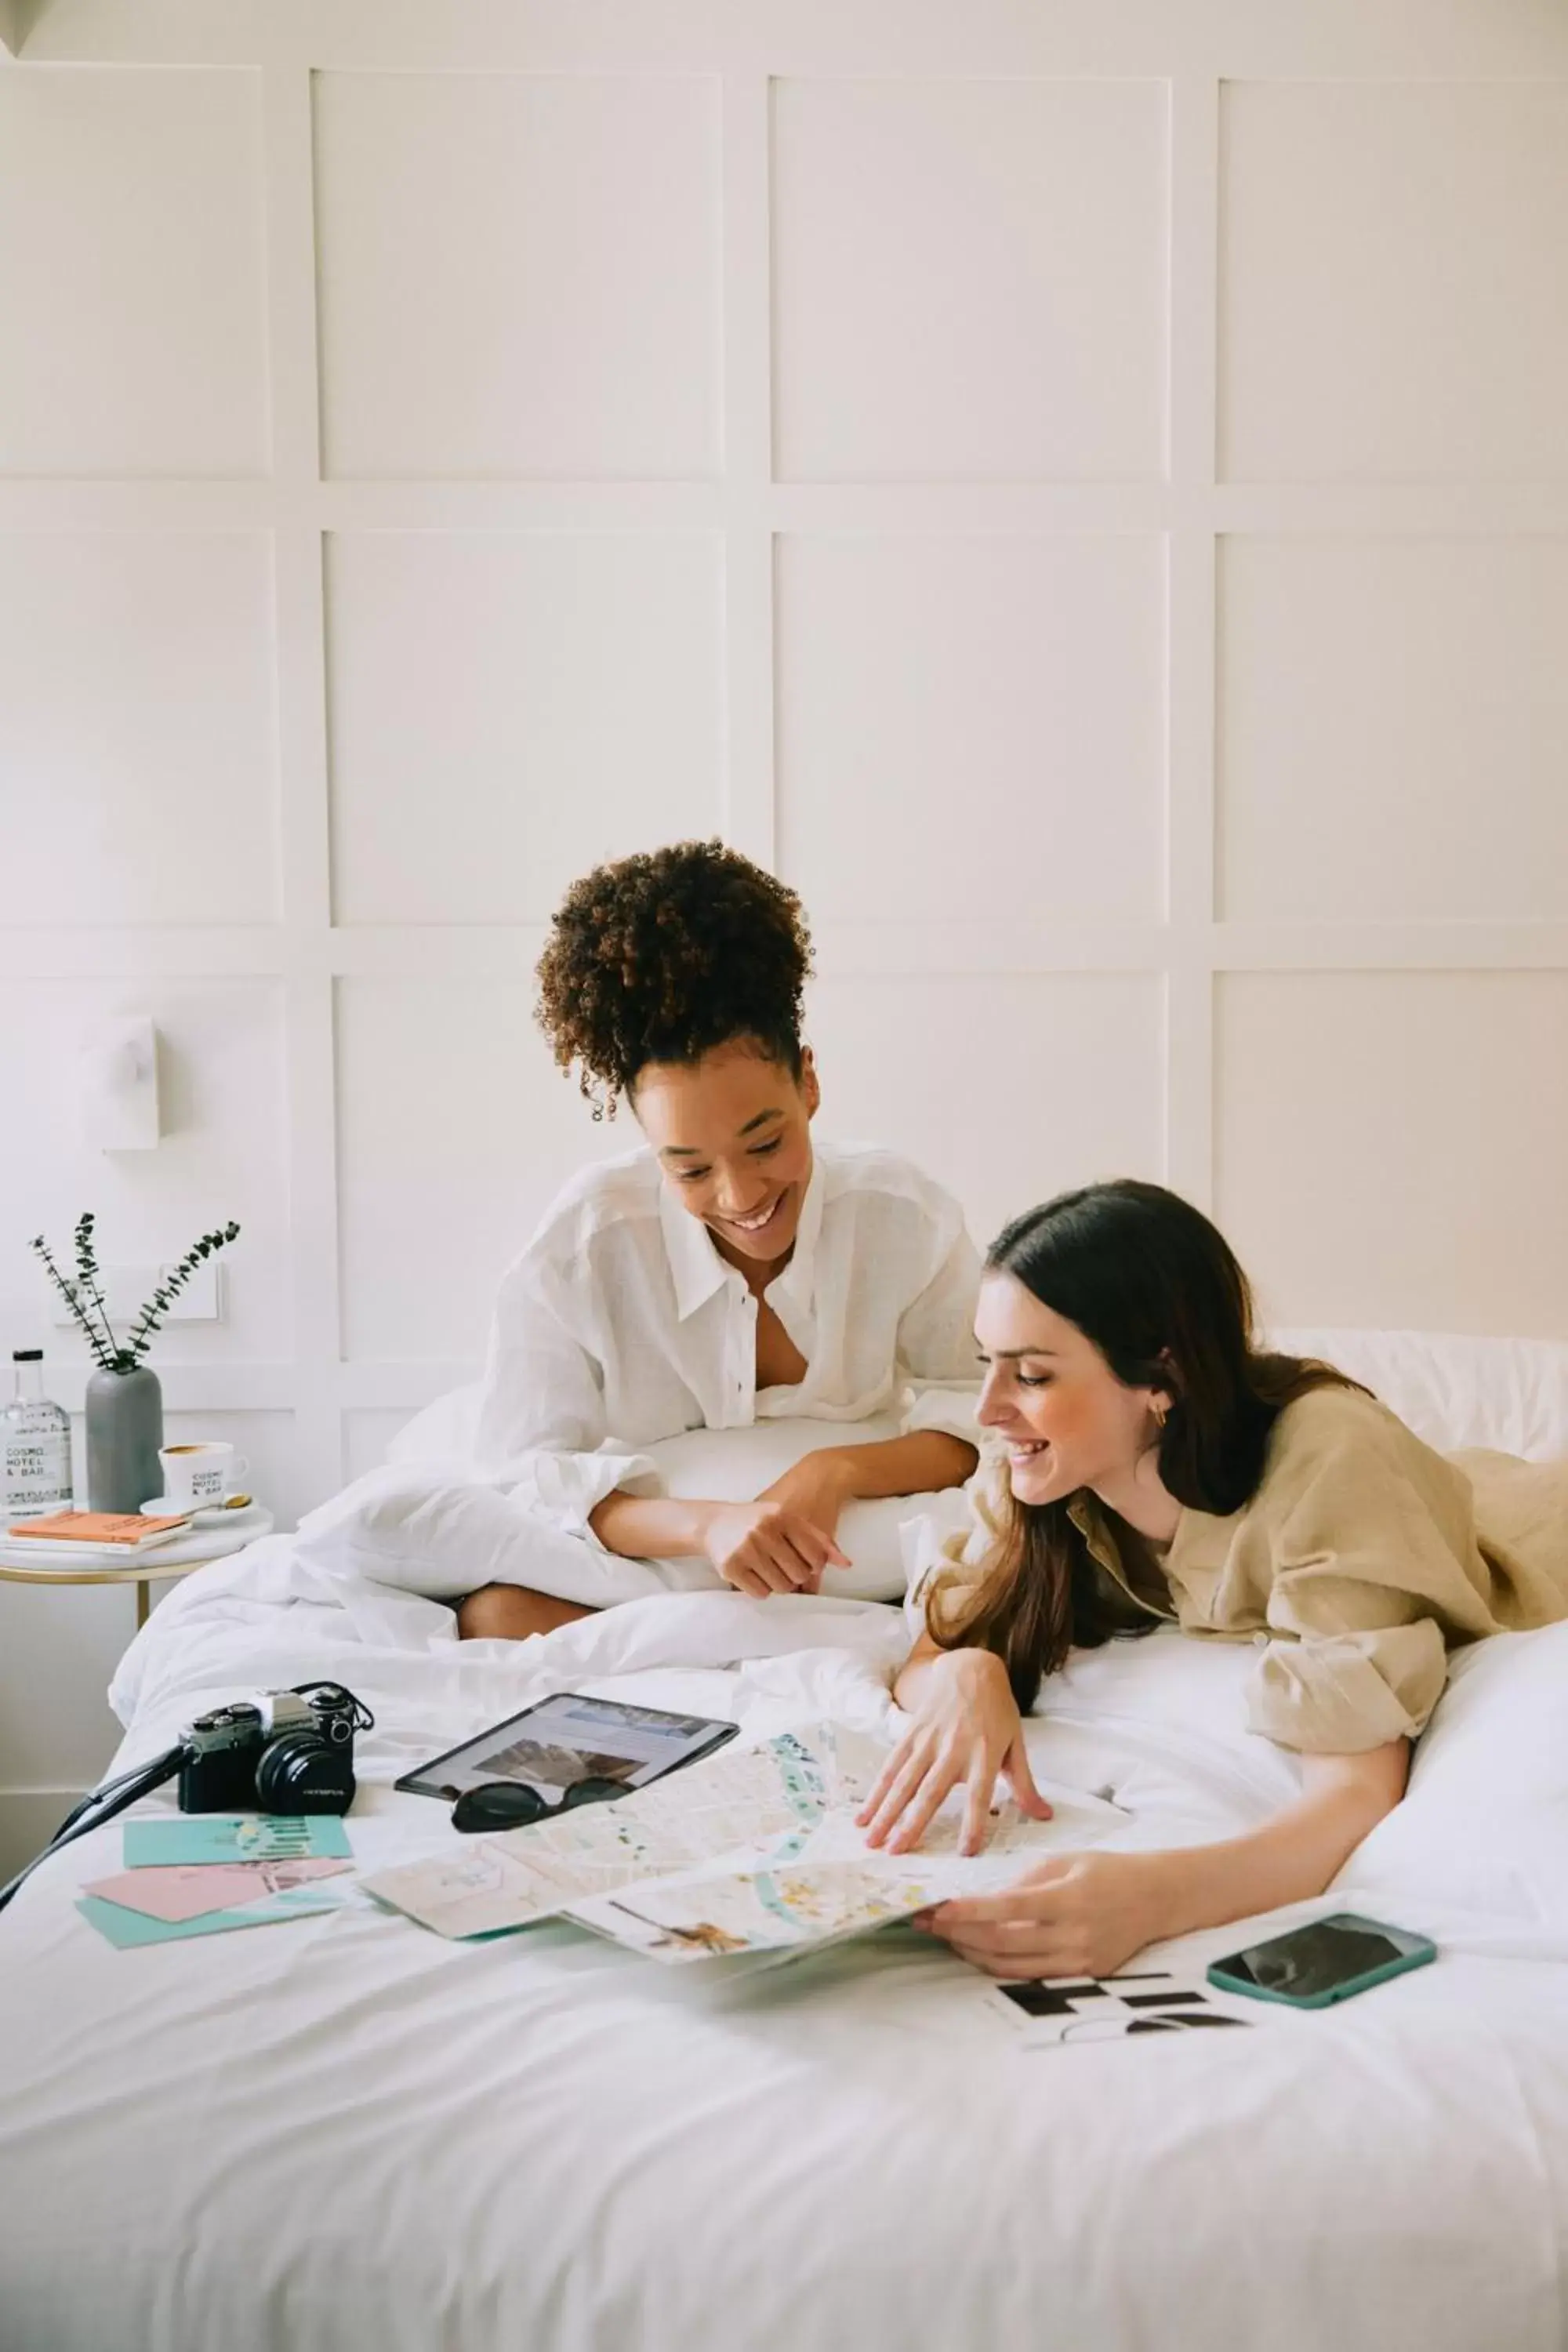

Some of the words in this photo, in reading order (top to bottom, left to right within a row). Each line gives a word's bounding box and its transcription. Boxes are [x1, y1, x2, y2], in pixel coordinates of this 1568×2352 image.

[6, 1446, 44, 1456] COSMO
[6, 1457, 42, 1466] HOTEL
[21, 1467, 43, 1476] BAR
